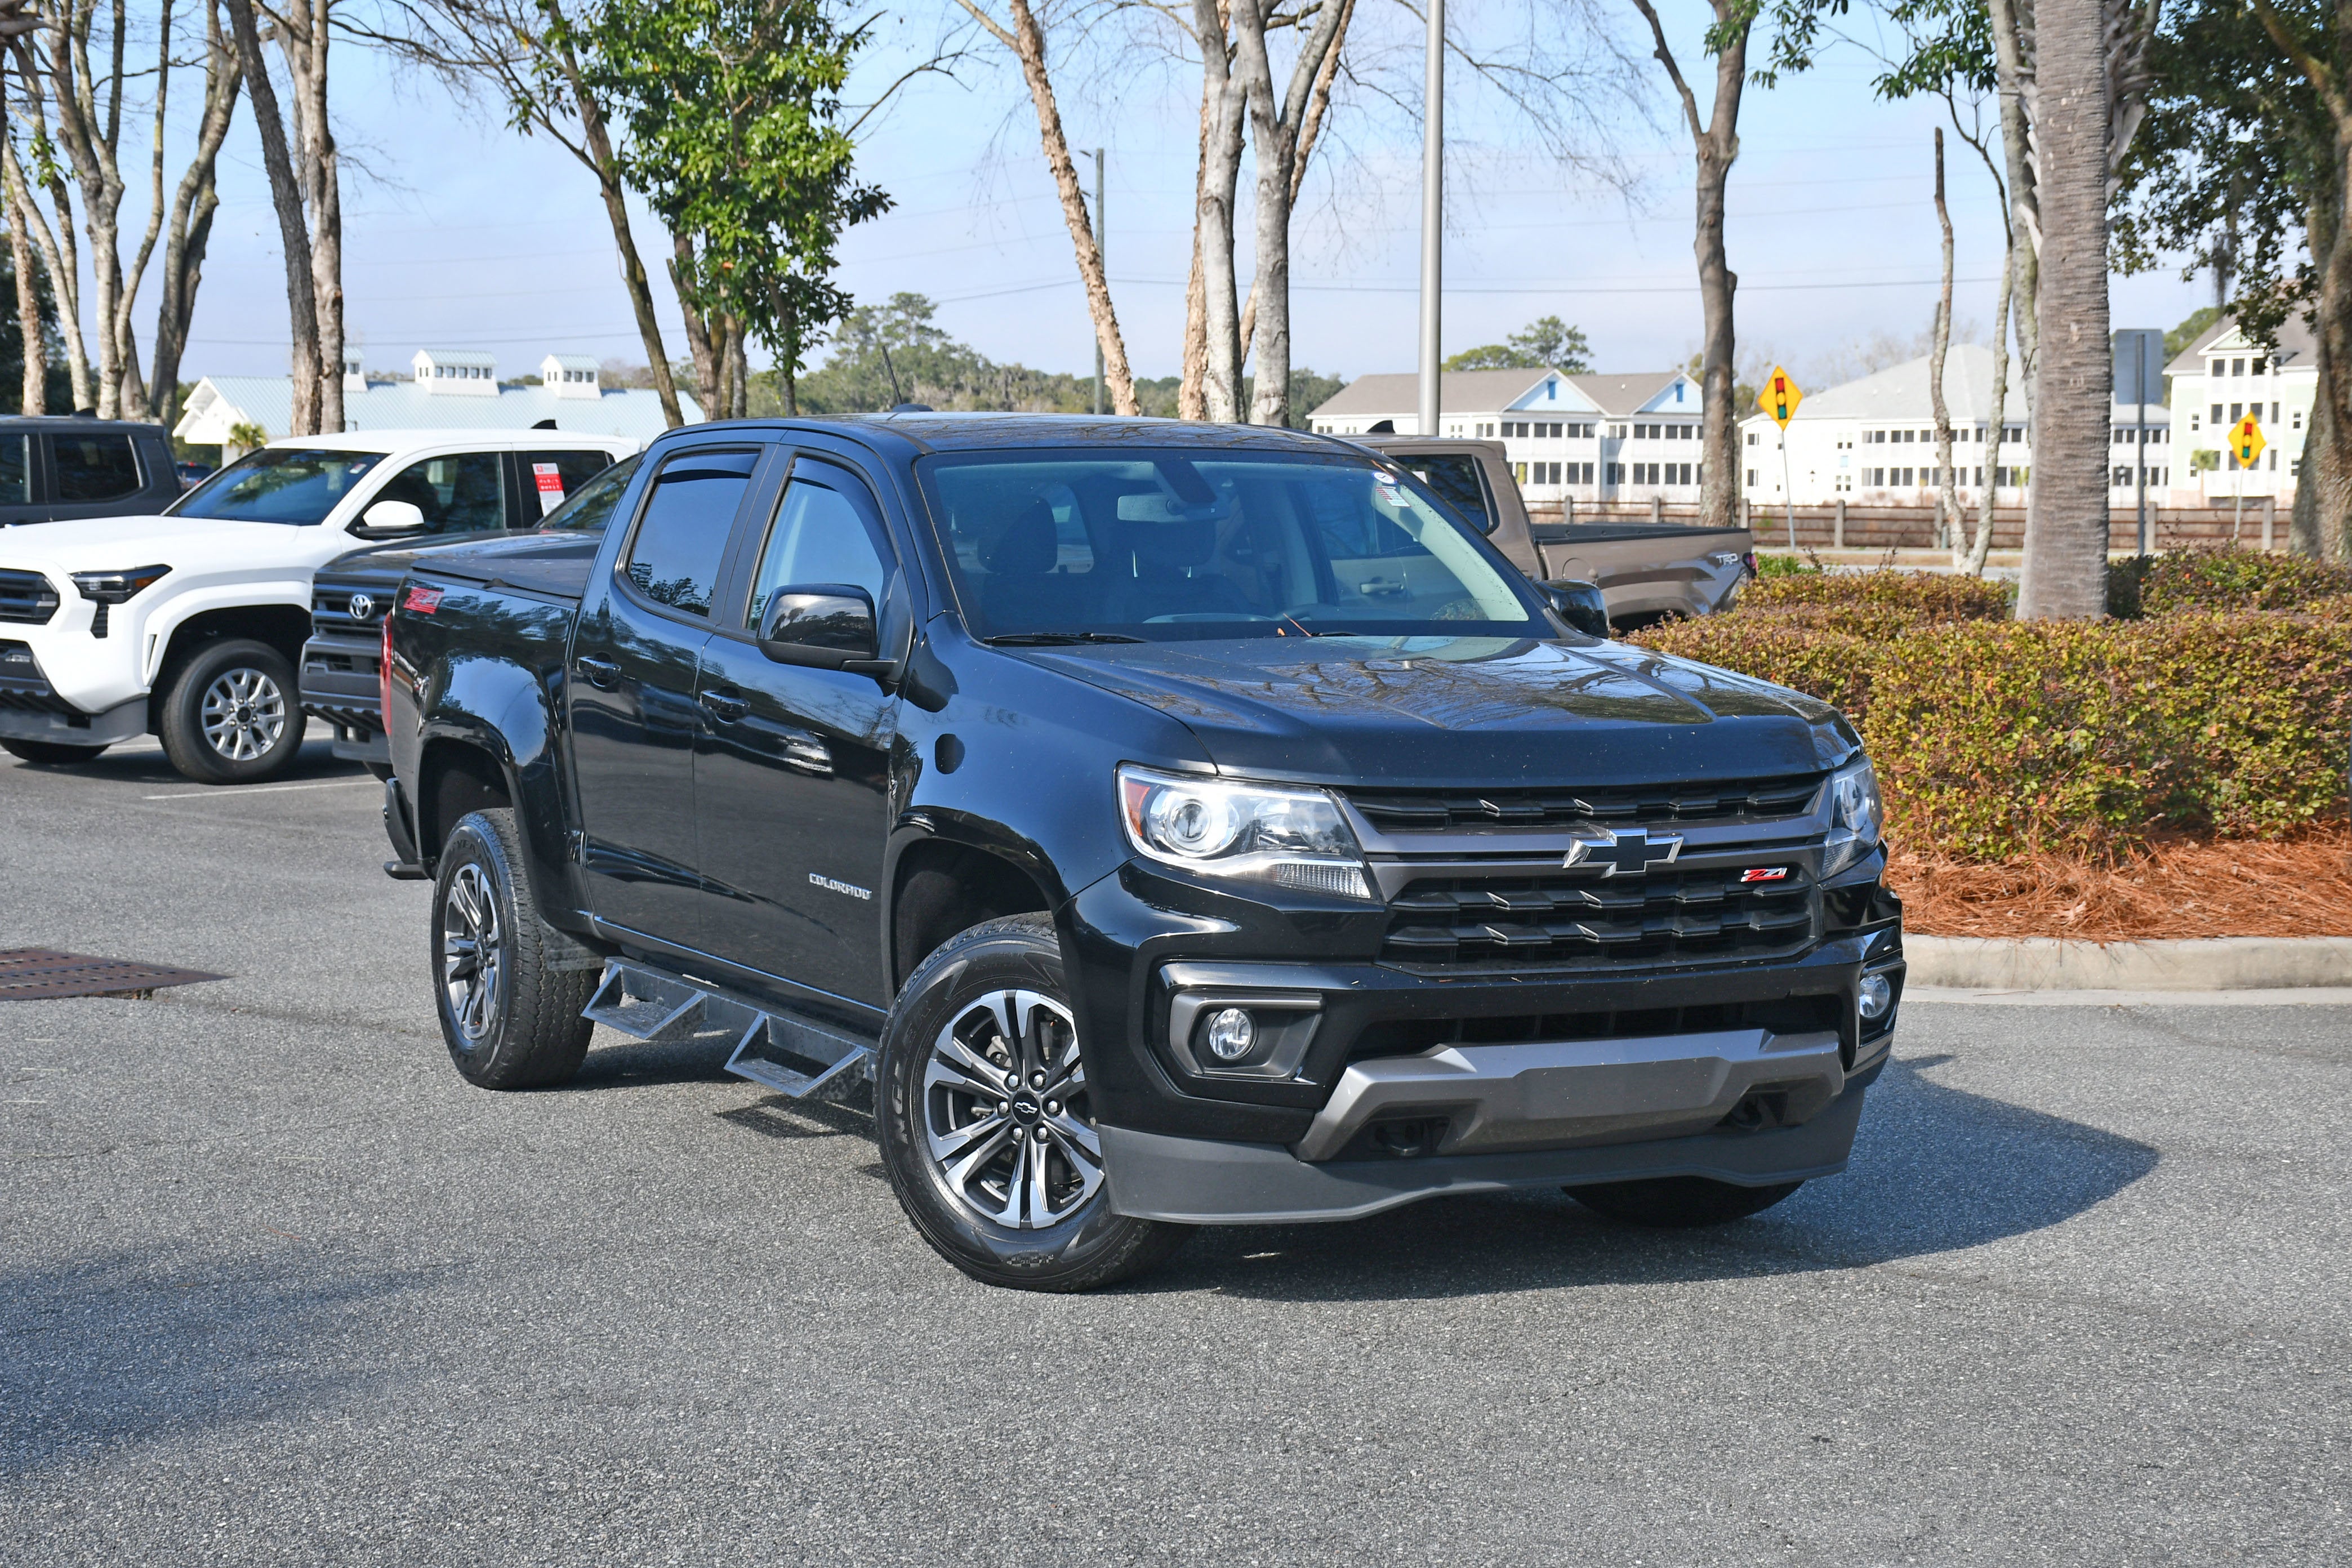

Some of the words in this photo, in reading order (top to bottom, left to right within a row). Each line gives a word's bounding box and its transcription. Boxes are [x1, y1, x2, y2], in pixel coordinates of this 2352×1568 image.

[1716, 553, 1739, 565] TRD
[1740, 867, 1788, 883] Z71
[809, 872, 872, 901] COLORADO
